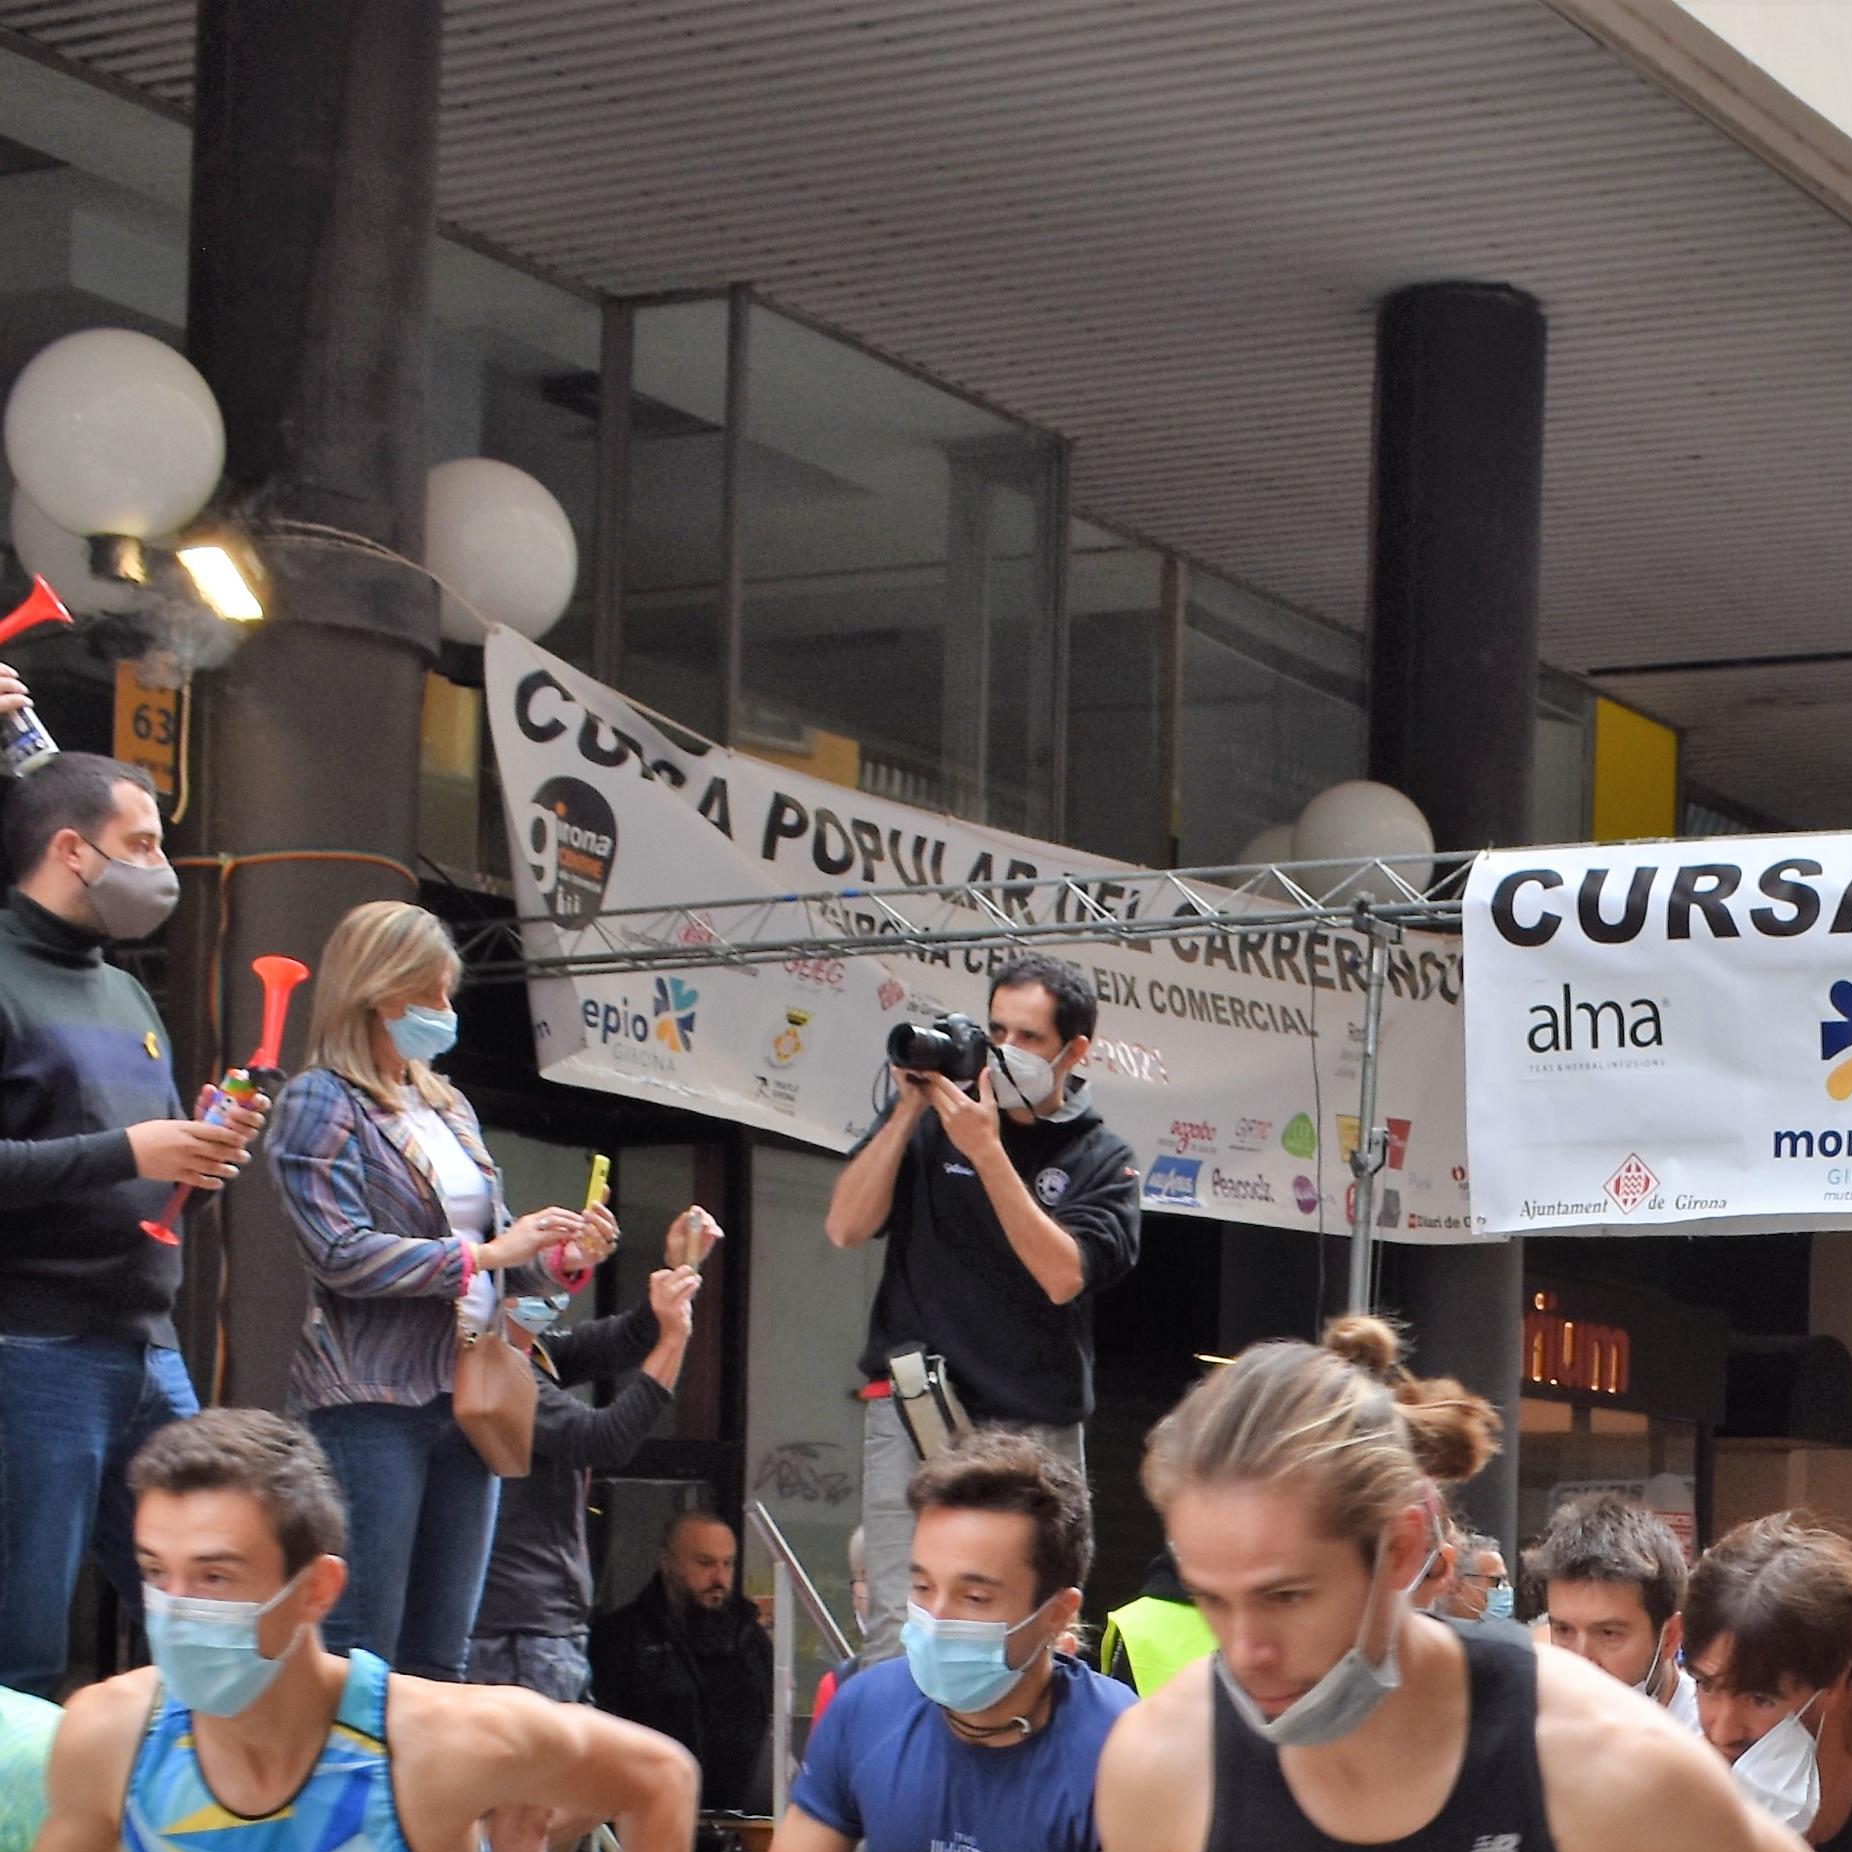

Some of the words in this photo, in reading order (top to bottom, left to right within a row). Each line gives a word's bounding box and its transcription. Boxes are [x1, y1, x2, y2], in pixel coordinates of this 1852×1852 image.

[132, 703, 174, 745] 63
[761, 790, 1038, 927] POPULAR
[1170, 901, 1371, 995] CARRER
[1093, 966, 1141, 1010] EIX
[1527, 983, 1663, 1053] alma
[1519, 1199, 1609, 1220] Ajuntament
[1648, 1194, 1665, 1211] de
[1674, 1194, 1728, 1212] Girona
